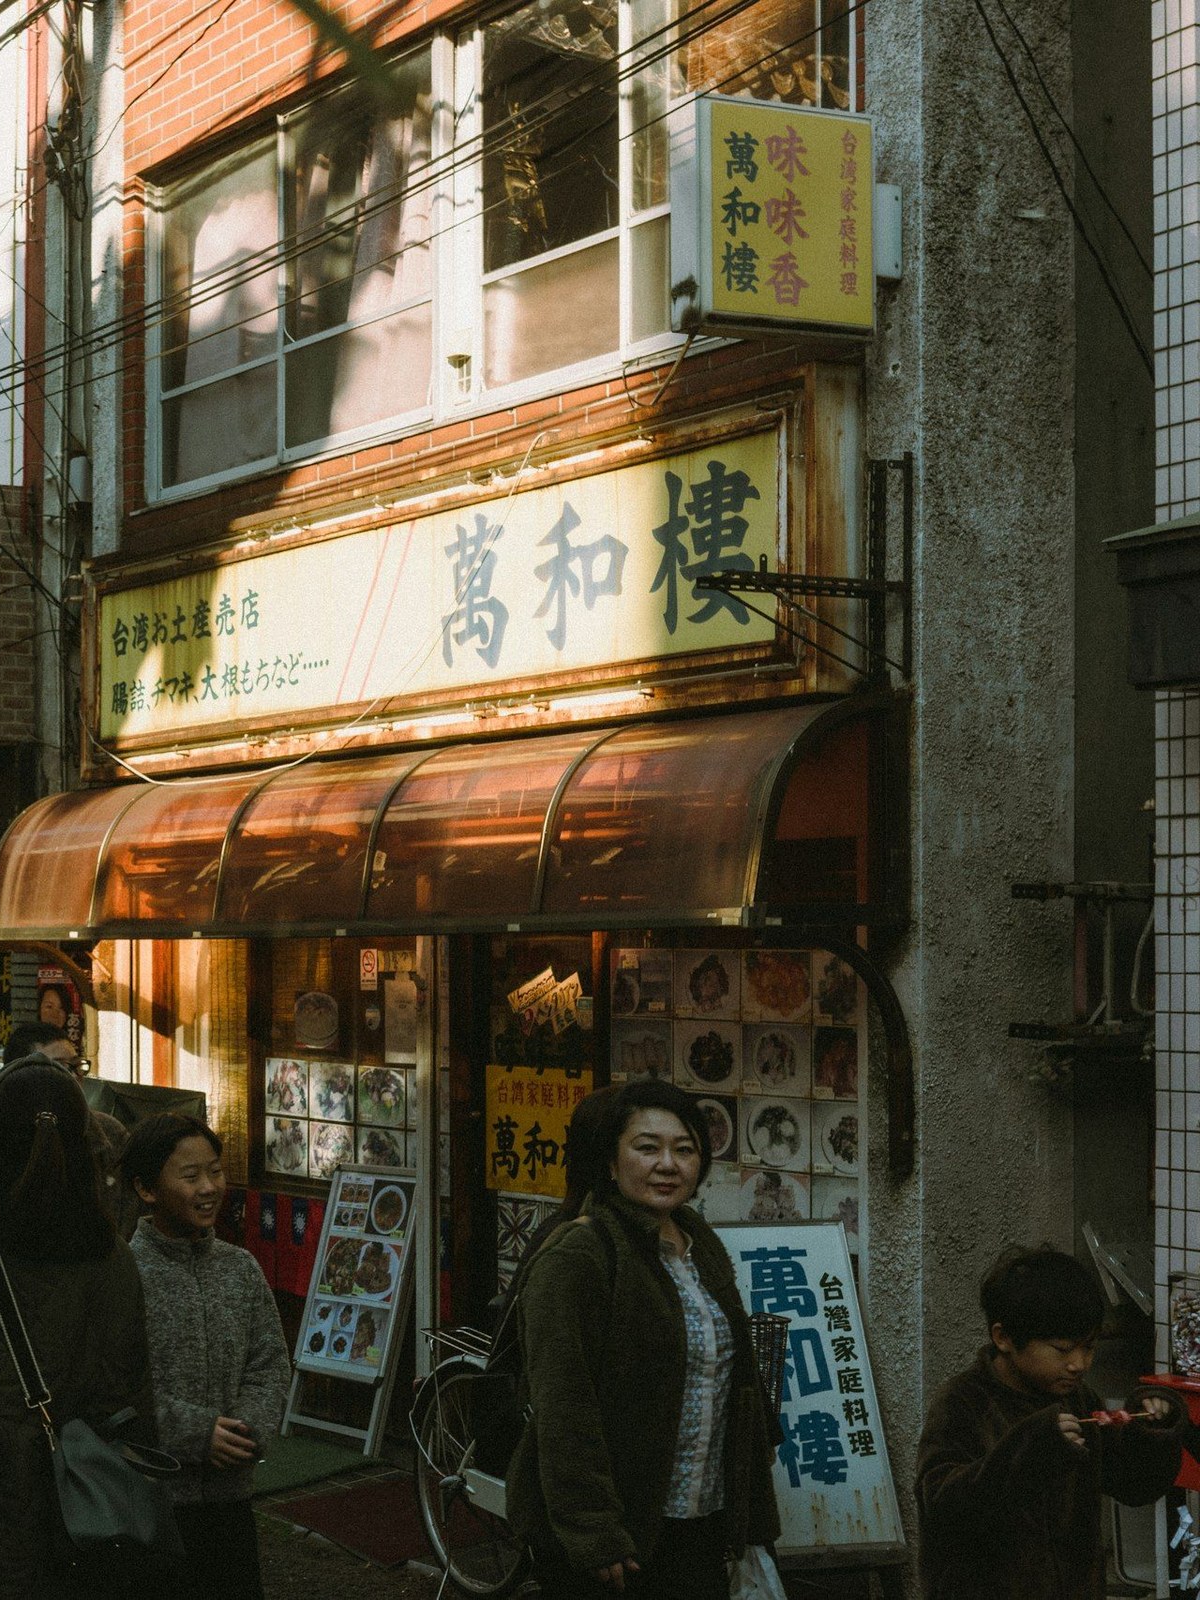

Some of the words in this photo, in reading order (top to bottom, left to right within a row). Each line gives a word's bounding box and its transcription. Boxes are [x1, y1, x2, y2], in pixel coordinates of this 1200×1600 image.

[721, 131, 761, 295] 萬和樓
[764, 125, 812, 307] 味味香
[112, 589, 260, 657] 台湾お土産売店
[439, 461, 761, 669] 萬和樓
[492, 1114, 573, 1181] 萬和
